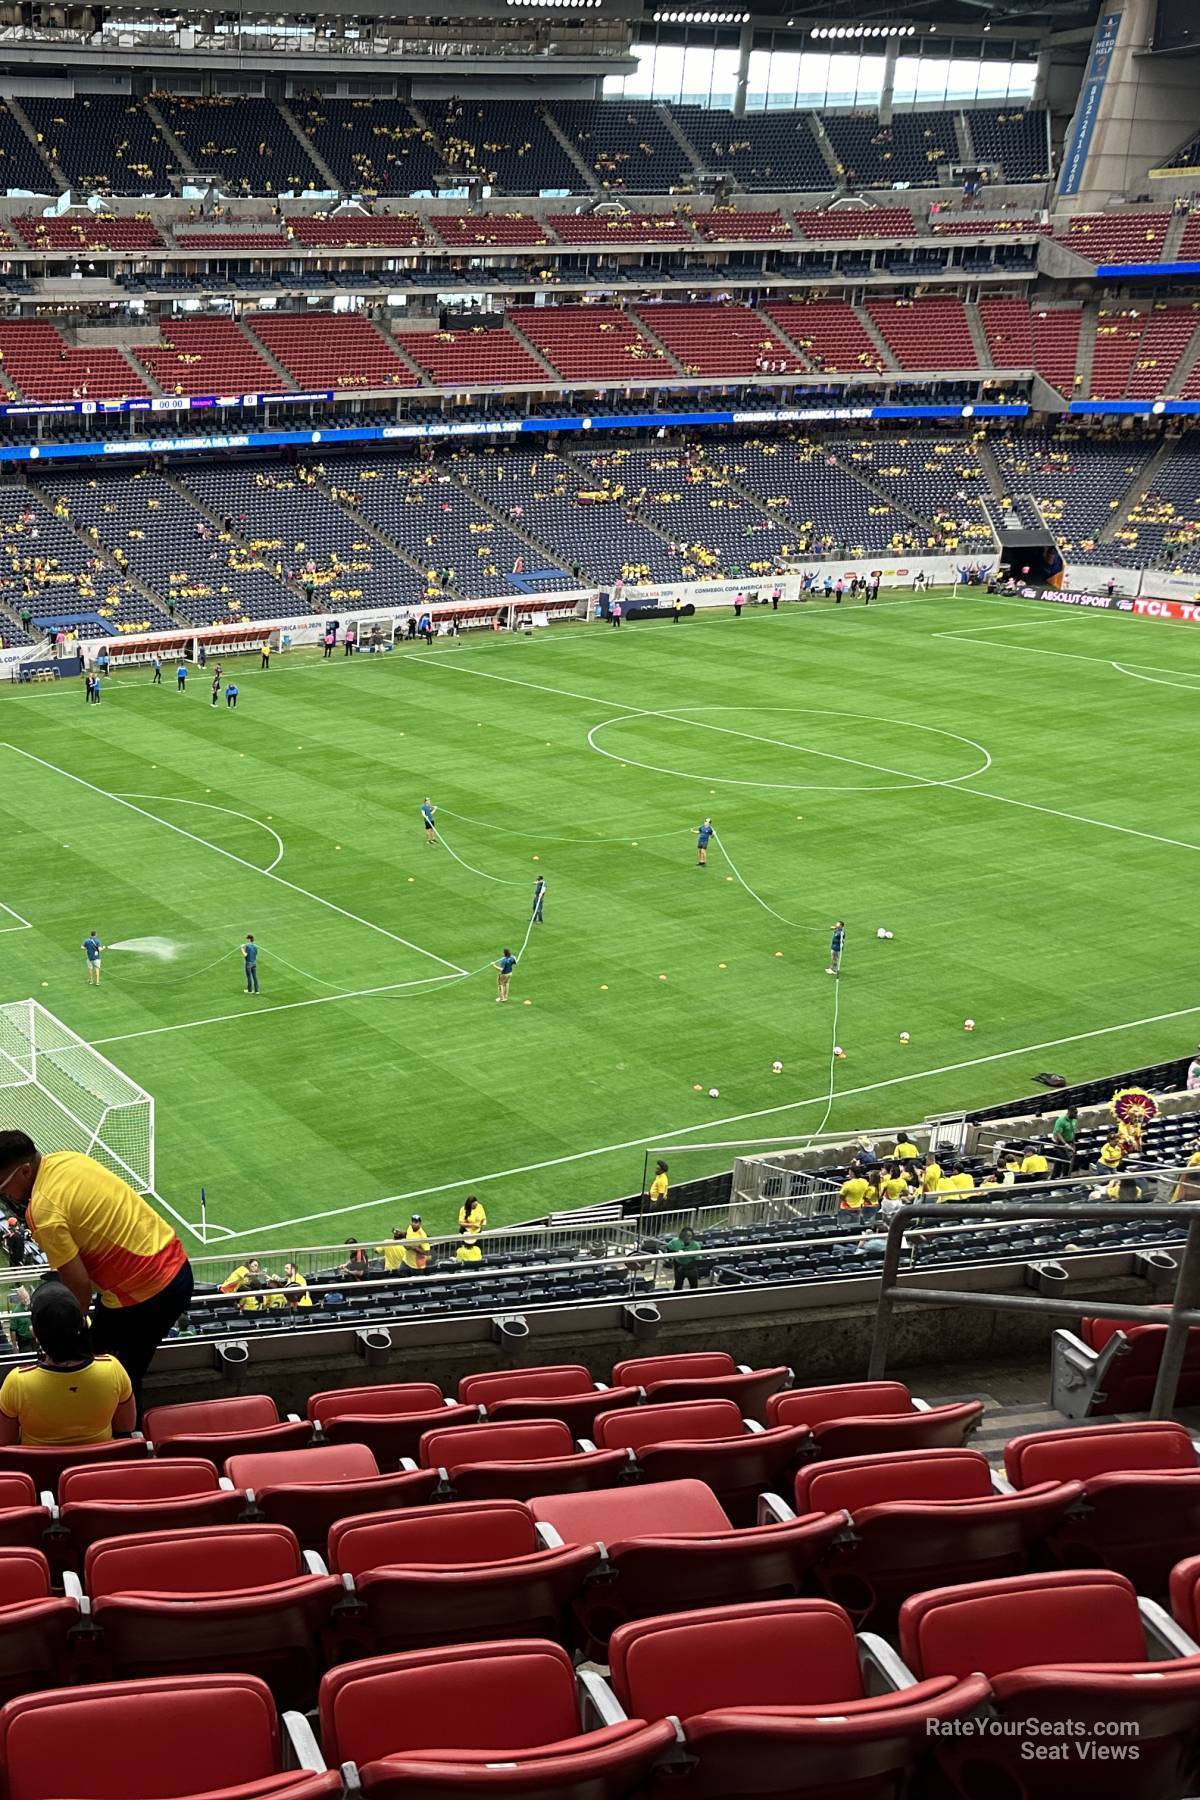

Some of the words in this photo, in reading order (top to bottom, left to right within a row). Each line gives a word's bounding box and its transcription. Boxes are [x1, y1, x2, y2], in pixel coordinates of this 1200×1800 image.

[1096, 40, 1114, 48] NEED
[1041, 590, 1081, 604] ABSOLUT
[1080, 596, 1112, 608] SPORT
[1135, 600, 1172, 617] TCL
[1180, 605, 1200, 621] TC
